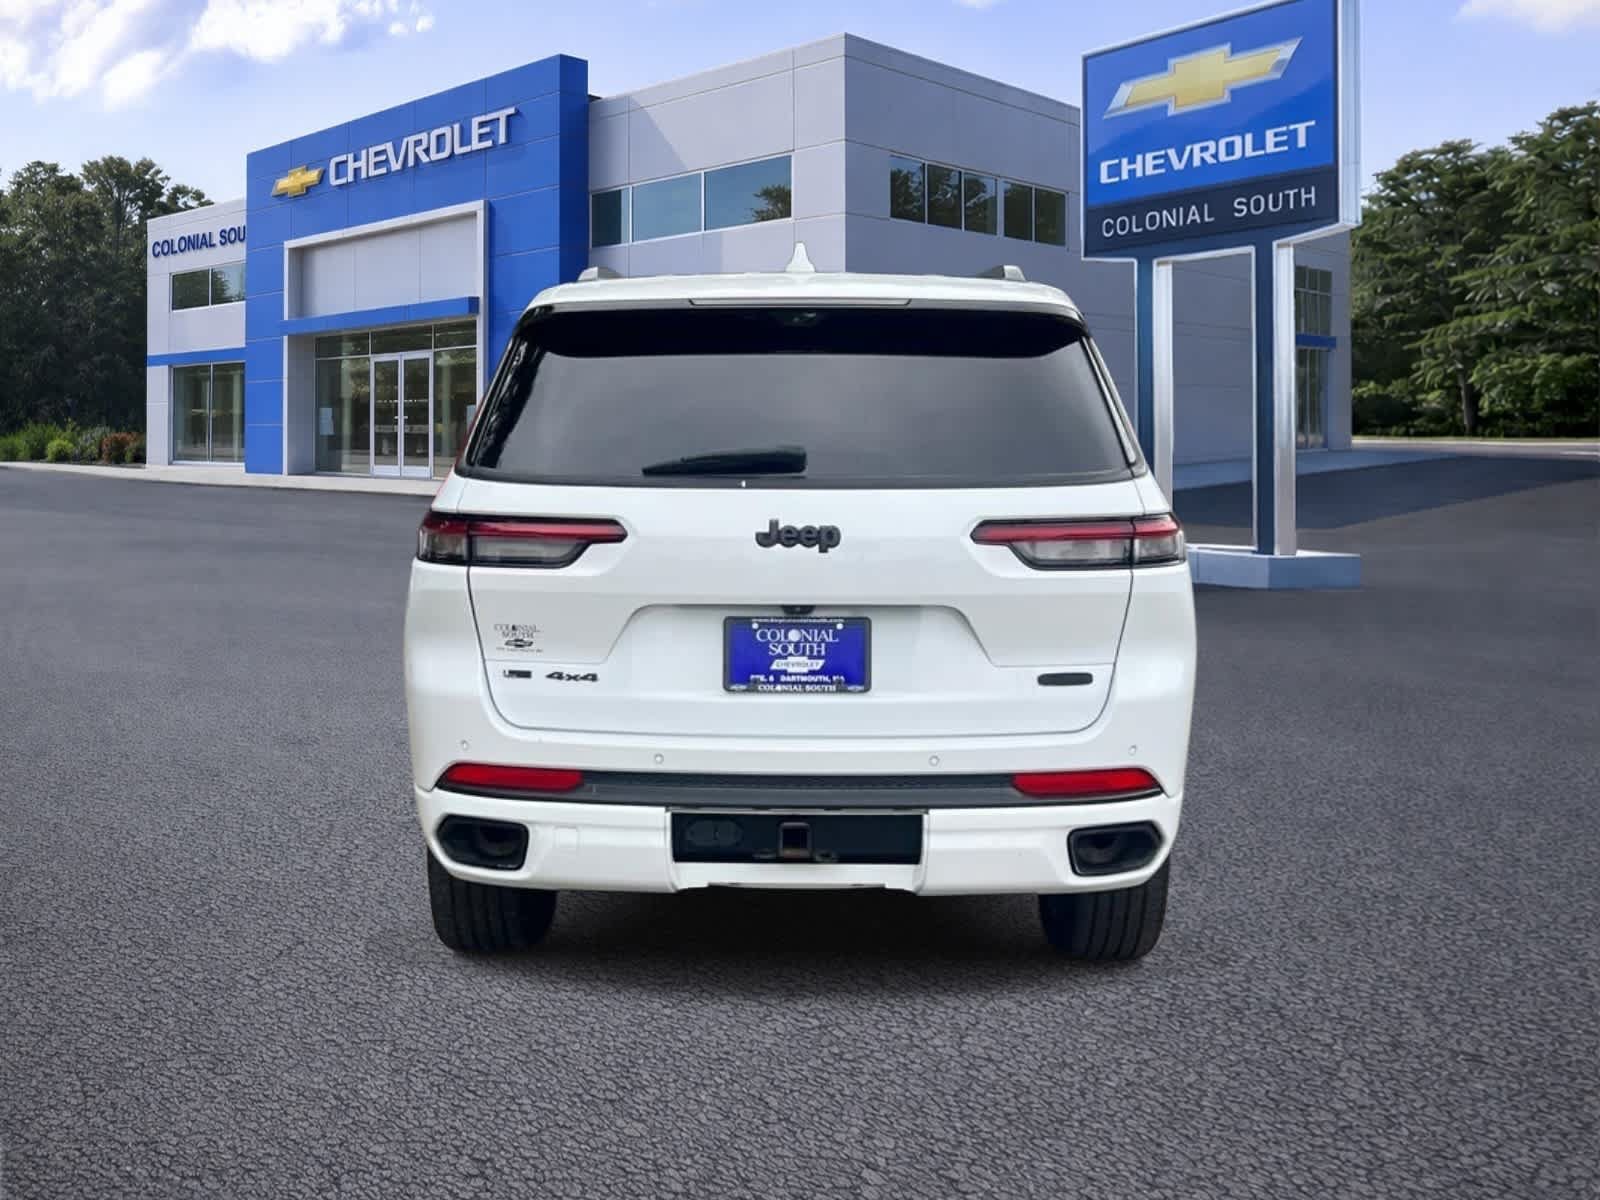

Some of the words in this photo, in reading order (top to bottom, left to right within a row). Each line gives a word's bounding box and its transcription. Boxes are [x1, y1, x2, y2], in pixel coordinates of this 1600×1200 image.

[329, 107, 519, 187] CHEVROLET
[1100, 120, 1316, 184] CHEVROLET
[1102, 203, 1215, 238] COLONIAL
[1233, 185, 1317, 218] SOUTH
[152, 231, 216, 258] COLONIAL
[755, 519, 841, 553] Jeep
[756, 629, 839, 642] COLONIAL
[768, 643, 826, 656] SOUTH
[545, 671, 598, 682] 4x4
